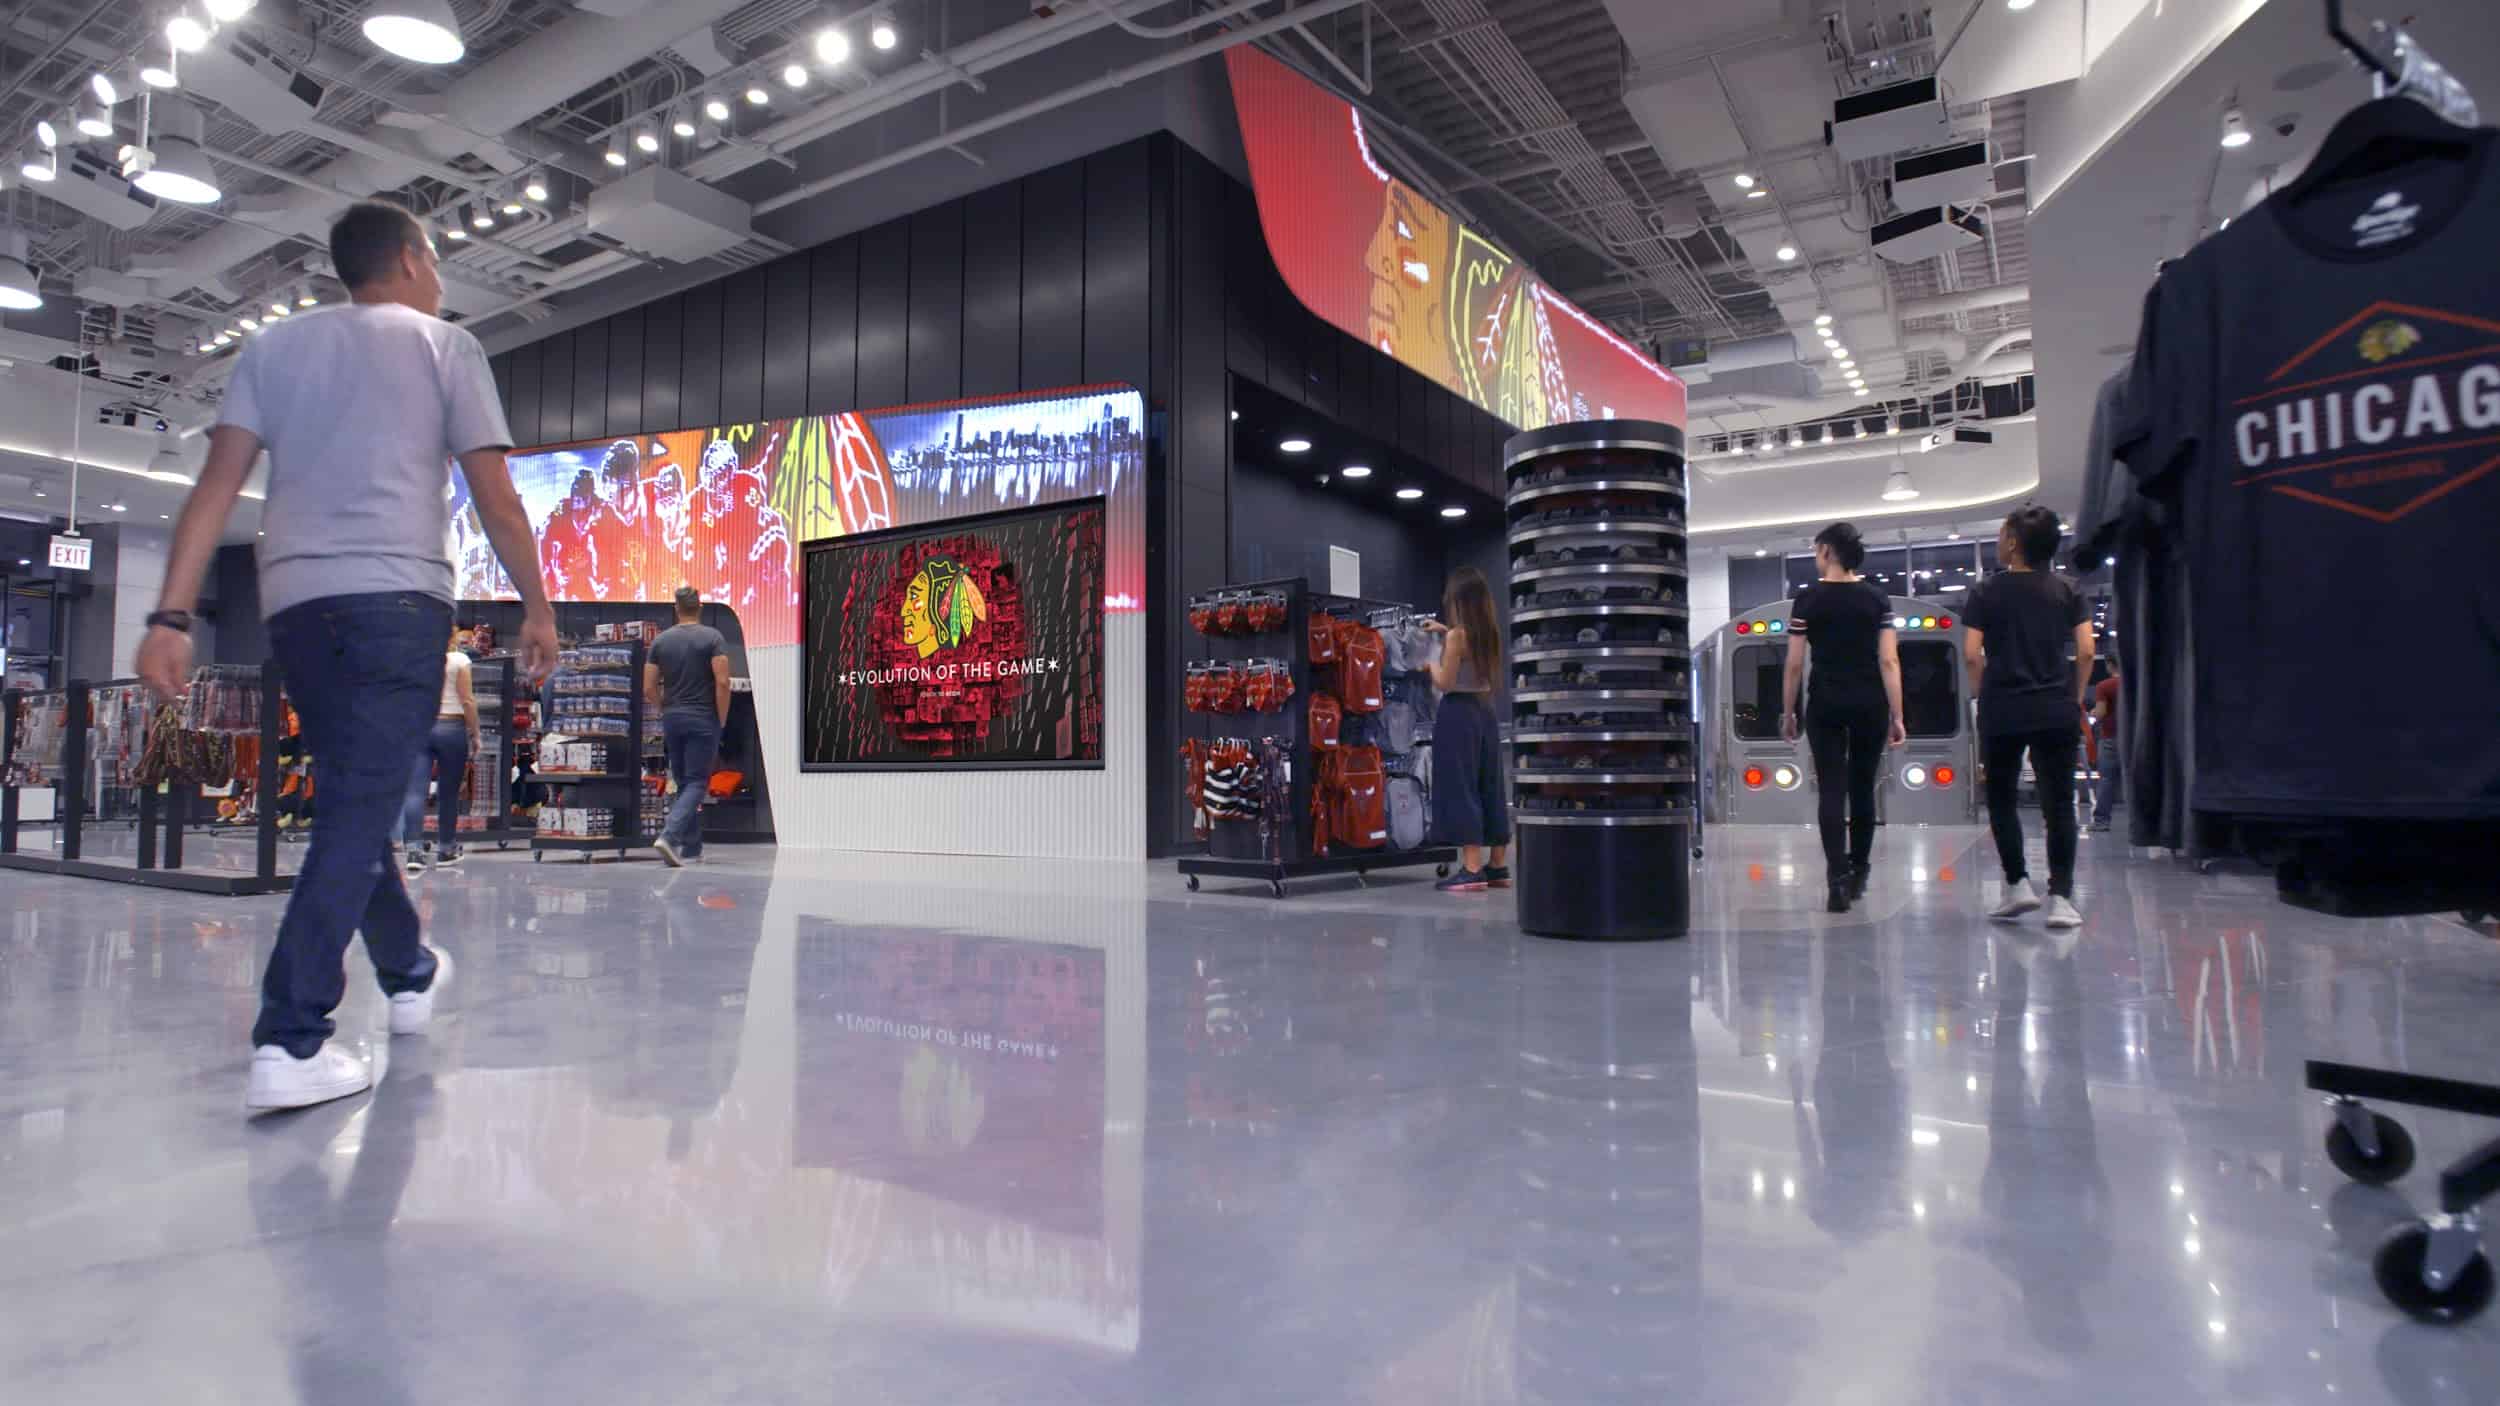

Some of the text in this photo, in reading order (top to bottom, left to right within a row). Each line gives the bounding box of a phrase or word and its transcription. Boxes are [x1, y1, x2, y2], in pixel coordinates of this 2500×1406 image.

[2235, 364, 2500, 467] CHICAG
[55, 546, 87, 565] EXIT
[849, 657, 1045, 686] EVOLUTION OF THE GAME
